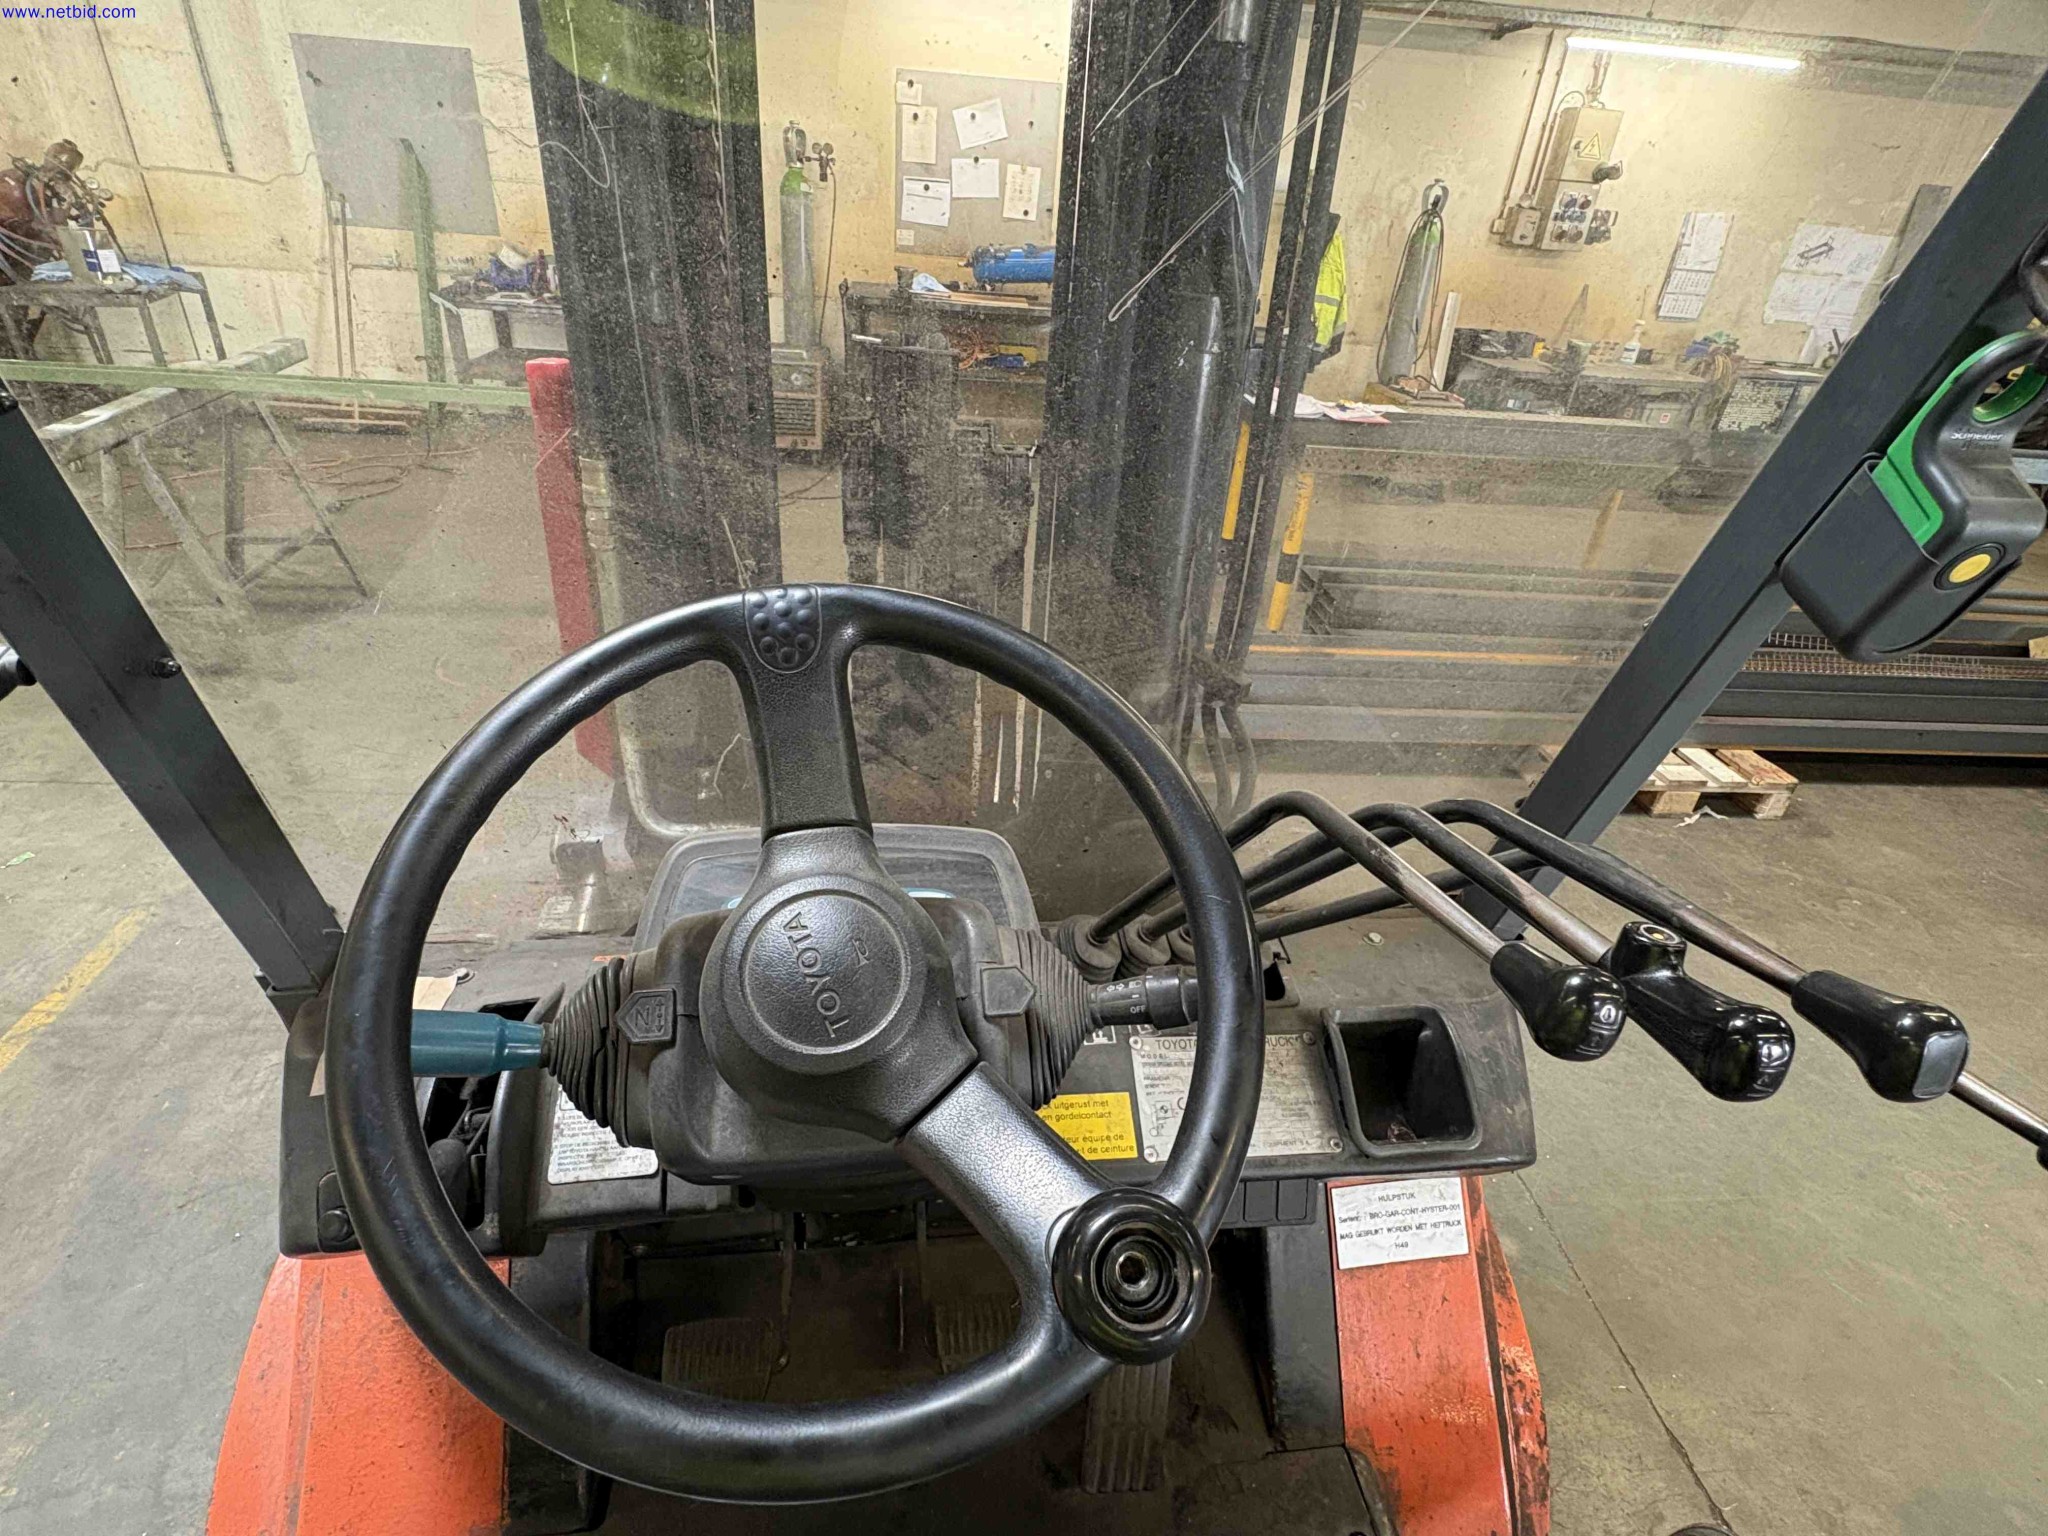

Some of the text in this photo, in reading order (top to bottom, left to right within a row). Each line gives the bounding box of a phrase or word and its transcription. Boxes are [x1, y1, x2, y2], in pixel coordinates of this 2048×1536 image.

[782, 910, 850, 1039] TOYOTA
[1130, 1004, 1147, 1015] OFF
[1092, 1099, 1109, 1108] met
[1112, 1133, 1125, 1141] de
[1086, 1146, 1099, 1154] de
[1378, 1192, 1416, 1202] HULPSTUK
[1386, 1223, 1413, 1234] WORDEN
[1414, 1222, 1428, 1231] MET
